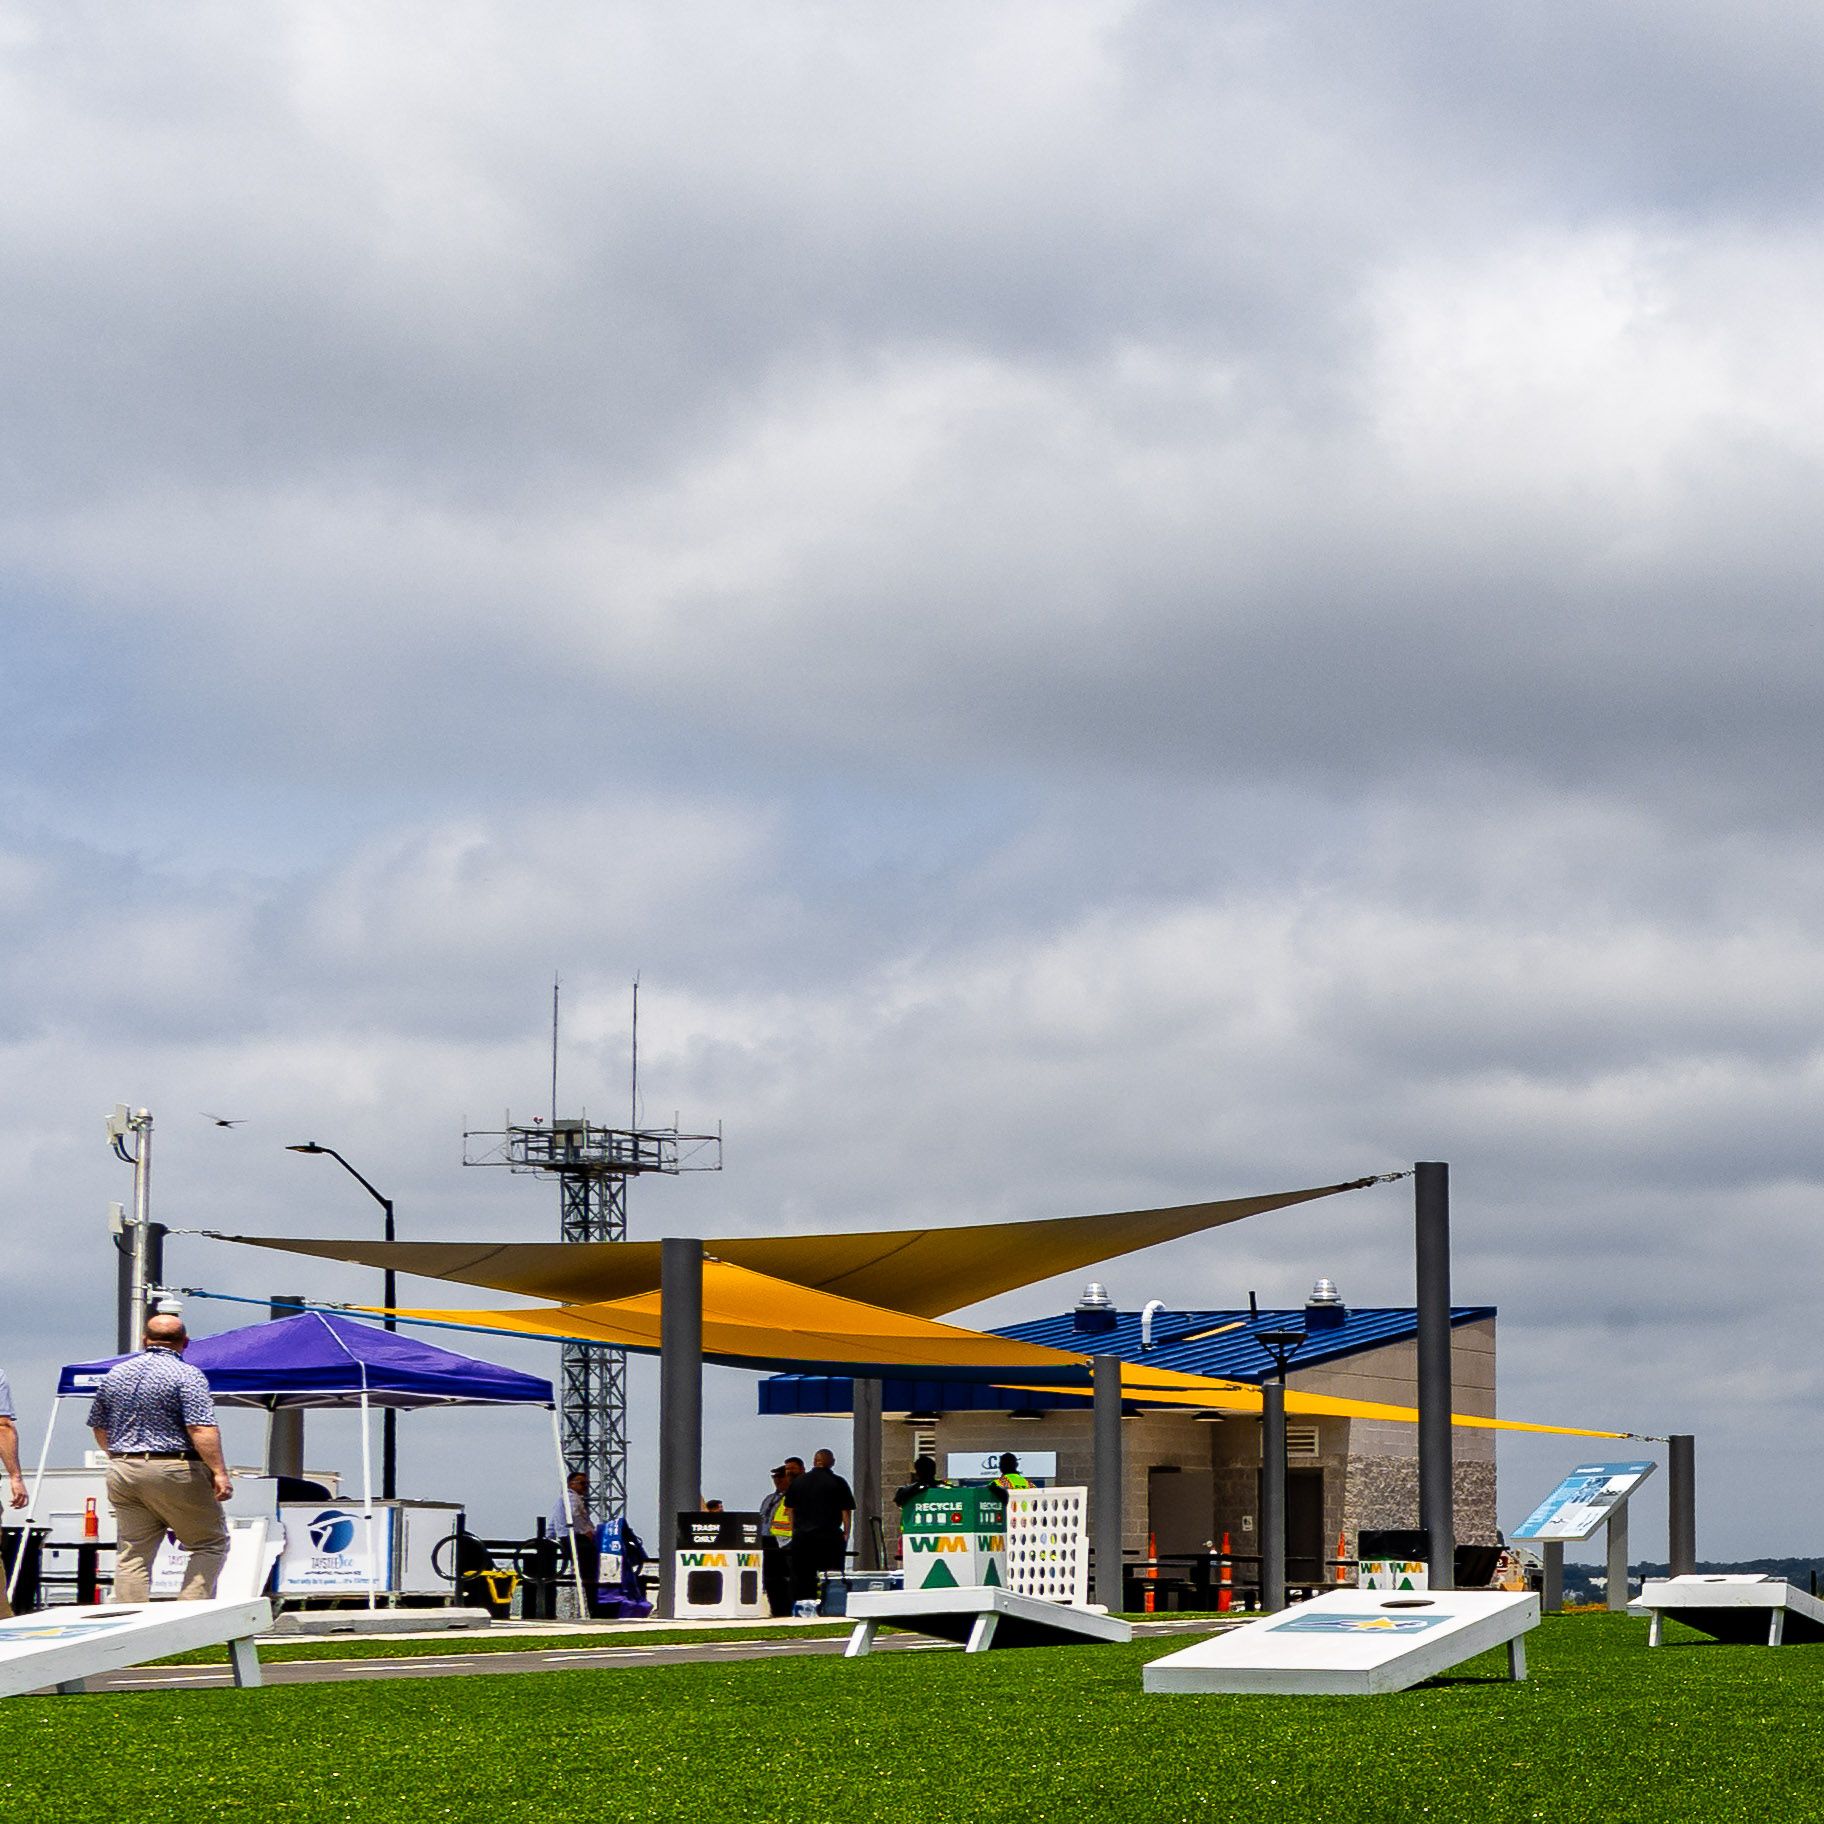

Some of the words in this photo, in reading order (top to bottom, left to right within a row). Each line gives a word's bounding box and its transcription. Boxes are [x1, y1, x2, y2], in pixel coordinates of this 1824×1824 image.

[915, 1502, 963, 1512] RECYCLE
[691, 1524, 721, 1532] TRASH
[909, 1535, 969, 1553] WM
[977, 1535, 1006, 1553] WM
[680, 1553, 729, 1568] WM
[737, 1553, 762, 1568] WM
[1360, 1562, 1383, 1574] WM
[1389, 1562, 1424, 1574] WM
